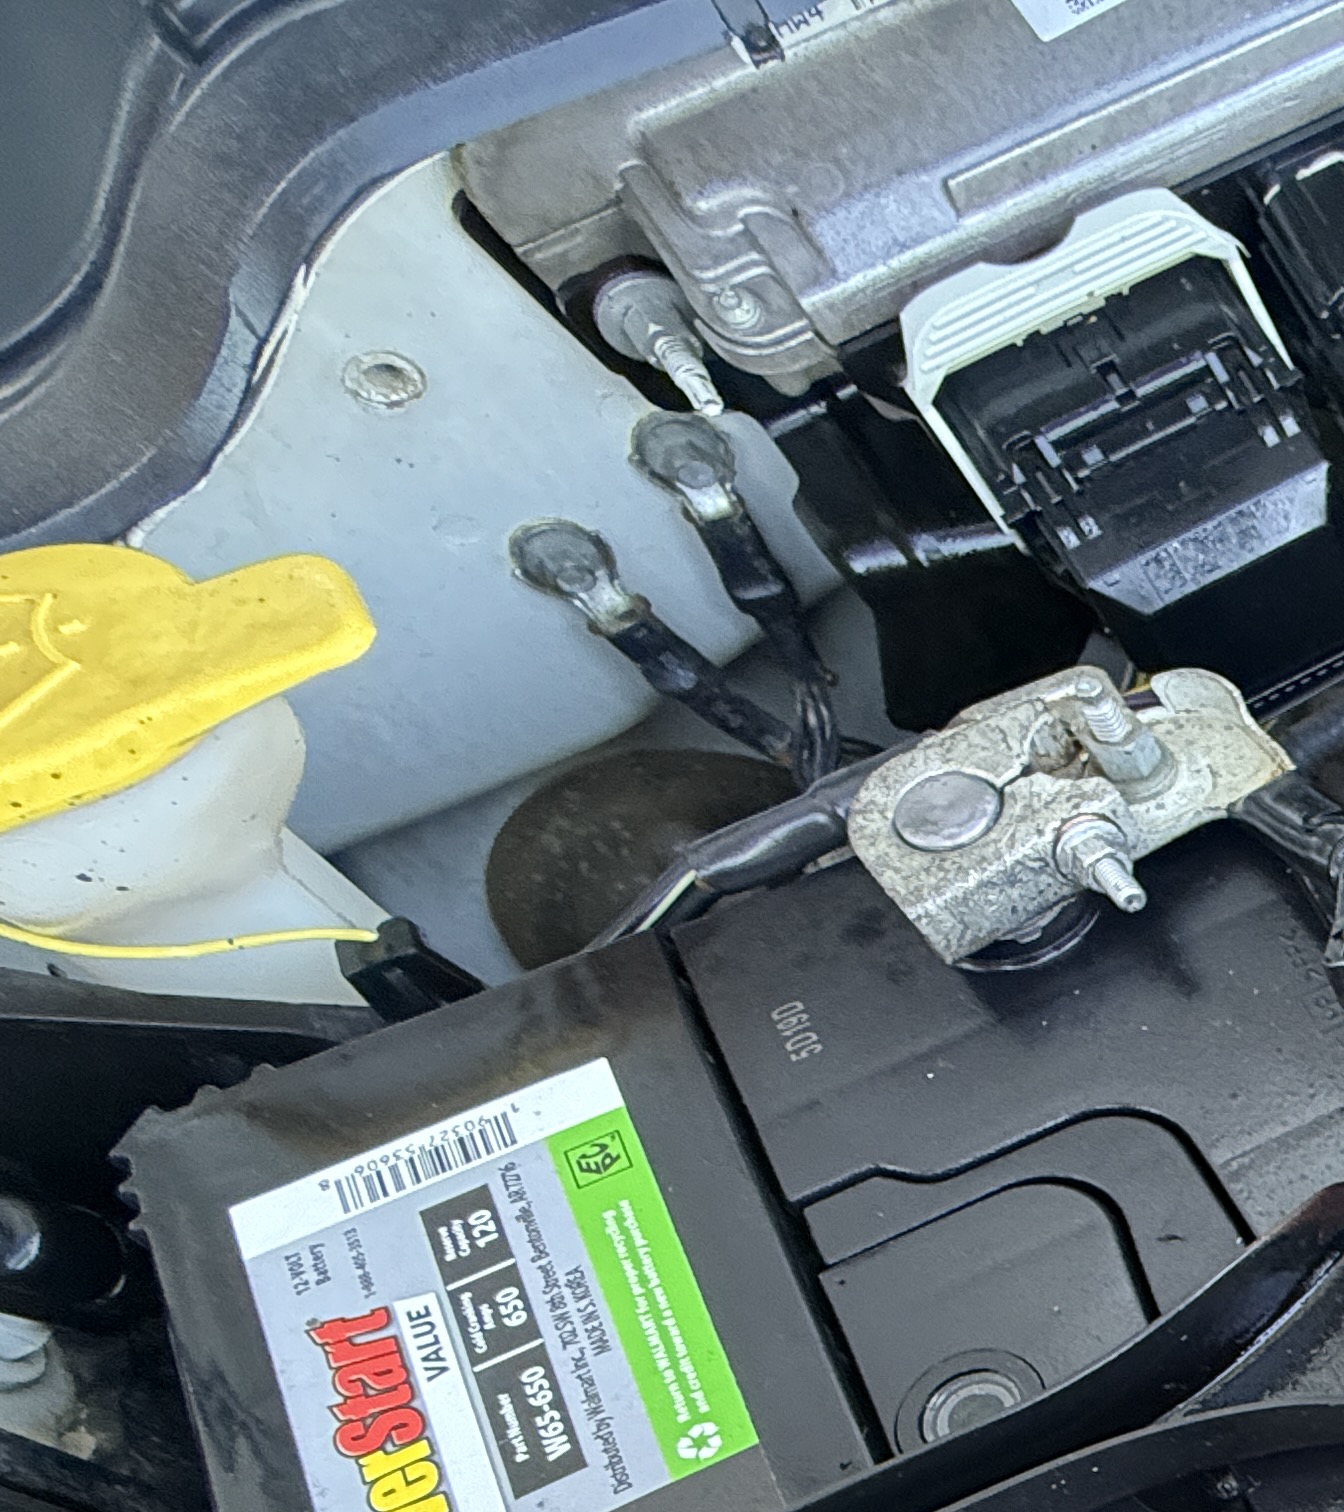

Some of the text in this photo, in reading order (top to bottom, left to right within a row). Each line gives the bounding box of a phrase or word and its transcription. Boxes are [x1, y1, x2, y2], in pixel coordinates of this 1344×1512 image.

[317, 1179, 330, 1191] 8
[437, 1226, 457, 1262] Reserve
[450, 1219, 471, 1257] Capacity
[467, 1209, 499, 1248] 120
[283, 1252, 311, 1296] 12-VOLT
[308, 1242, 332, 1286] Battery
[532, 1259, 562, 1296] Street
[559, 1263, 593, 1305] KOREA
[478, 1303, 496, 1330] Amps
[495, 1286, 527, 1327] 650
[543, 1290, 568, 1314] 8th
[550, 1308, 575, 1333] SW
[578, 1308, 602, 1327] IN
[601, 1209, 691, 1423] Return to WALMART for proper recycling
[618, 1199, 710, 1413] and credit toward a new battery purchase
[459, 1291, 487, 1354] Cold Cranking
[556, 1325, 582, 1351] 702
[582, 1320, 613, 1358] MADE
[406, 1305, 450, 1382] VALUE
[519, 1365, 571, 1462] W65-650
[571, 1369, 607, 1422] Walmart
[497, 1393, 530, 1462] Part Number
[587, 1412, 617, 1436] by
[592, 1429, 633, 1496] Distributed
